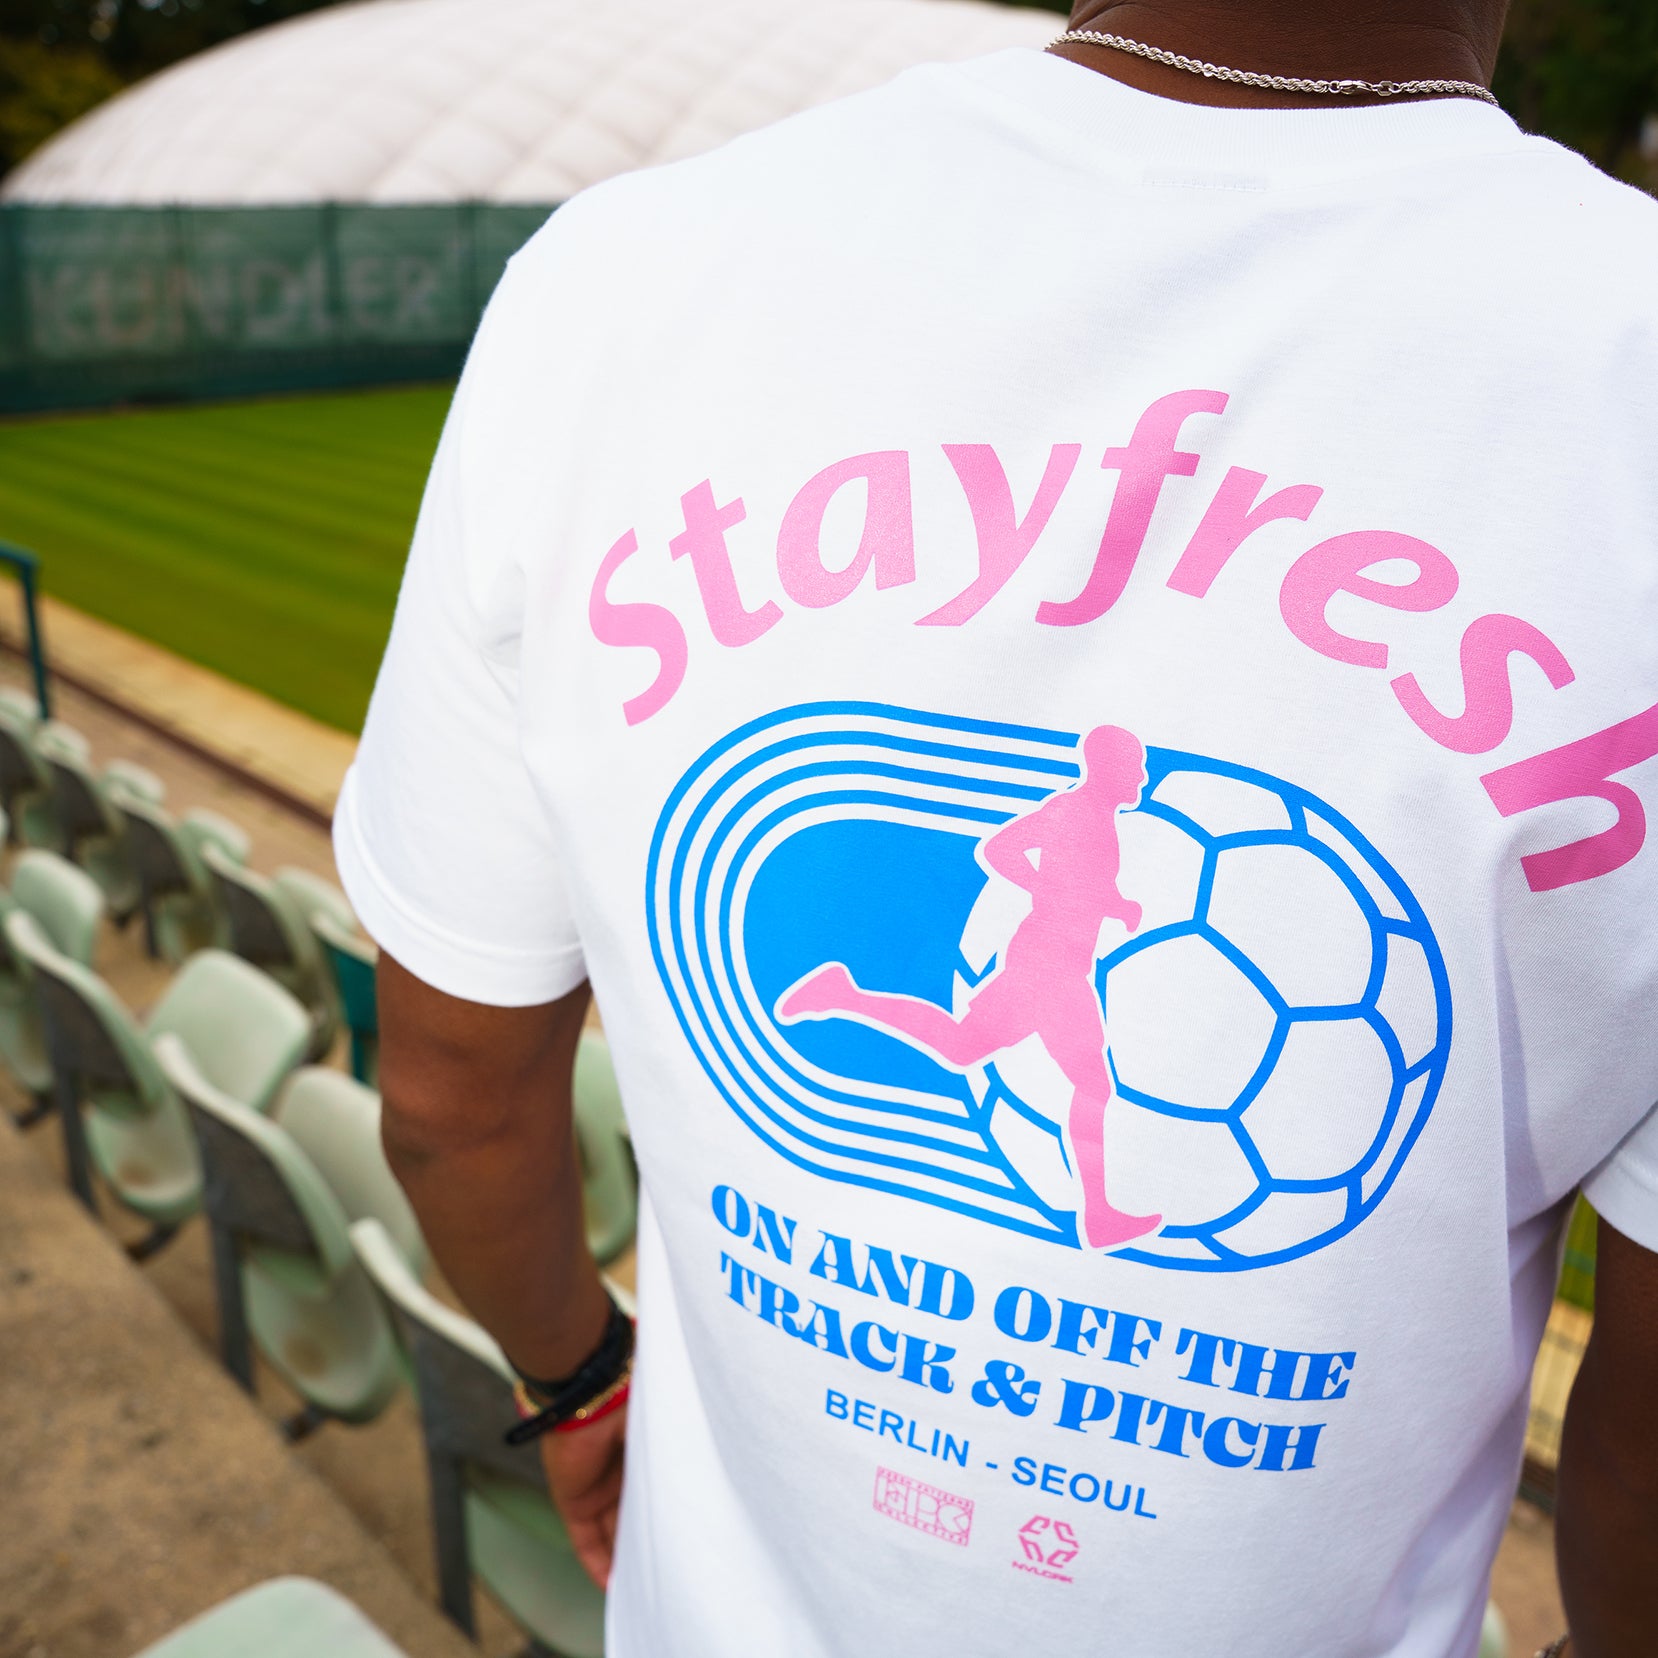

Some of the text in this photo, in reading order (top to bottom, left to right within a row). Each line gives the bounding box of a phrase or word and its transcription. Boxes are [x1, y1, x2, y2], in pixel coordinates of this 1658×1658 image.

[588, 389, 1658, 893] Stayfresh
[710, 1184, 1357, 1402] ON AND OFF THE
[720, 1250, 1327, 1472] TRACK & PITCH
[825, 1388, 1157, 1520] BERLIN - SEOUL
